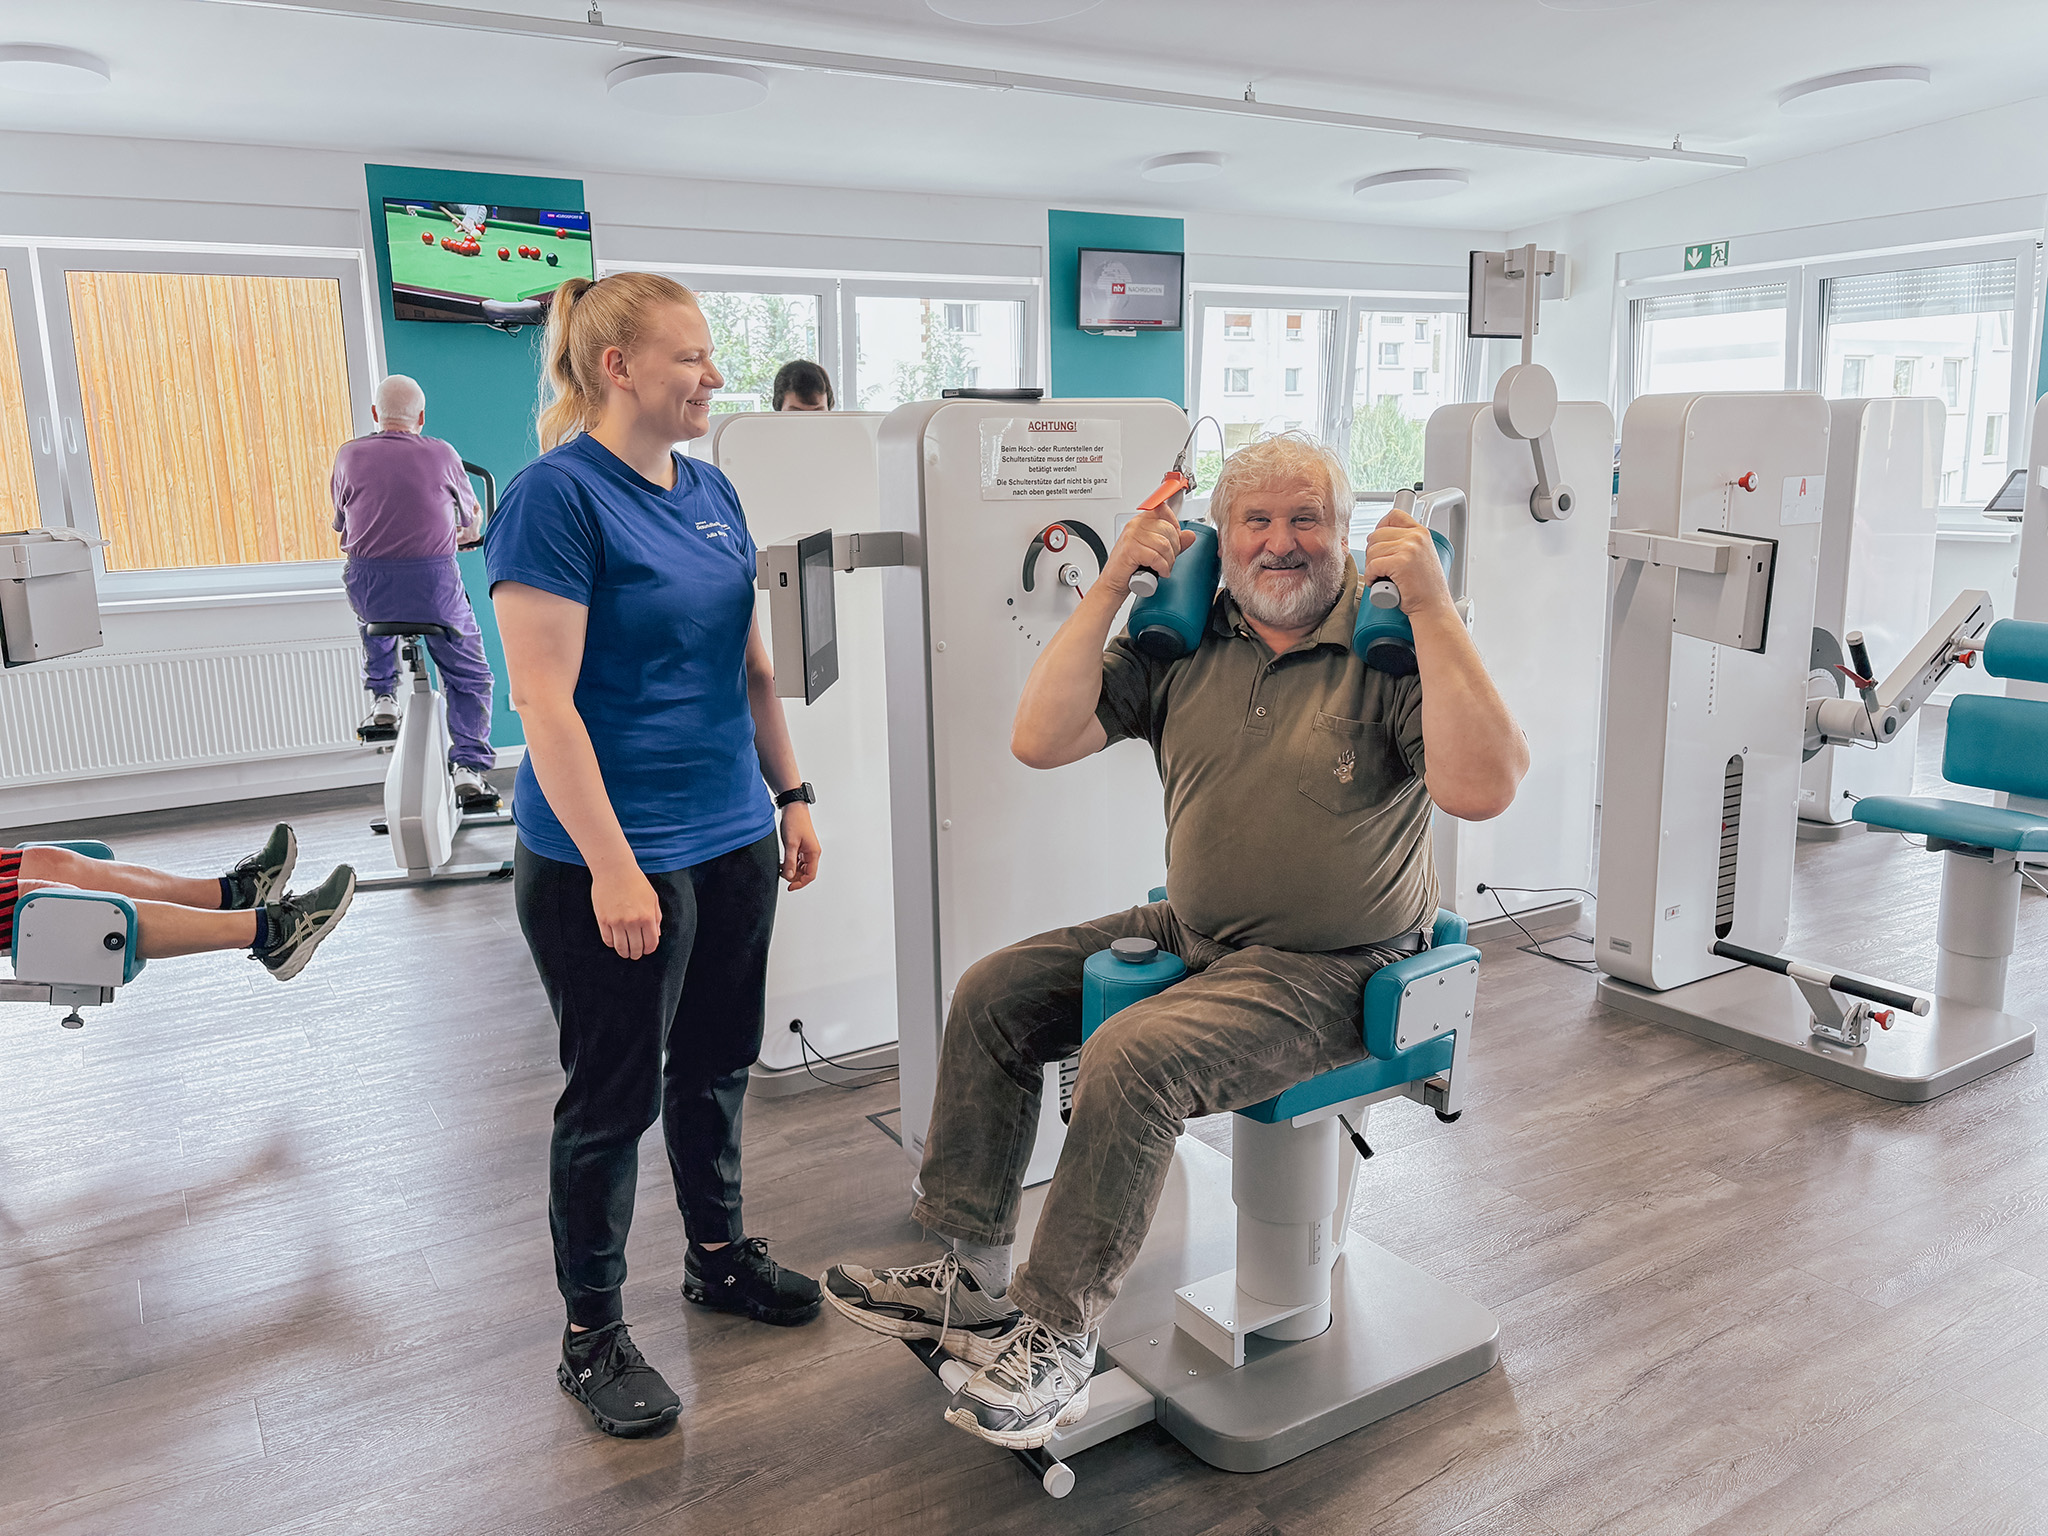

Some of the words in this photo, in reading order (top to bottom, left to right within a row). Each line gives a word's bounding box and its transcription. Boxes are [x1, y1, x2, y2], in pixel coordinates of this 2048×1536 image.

[1113, 284, 1124, 292] ntv
[1028, 421, 1077, 432] ACHTUNG!
[1001, 455, 1046, 463] Schulterstütze
[1089, 455, 1103, 463] Griff
[1028, 466, 1052, 474] betätigt
[1008, 478, 1052, 486] Schulterstütze
[1053, 477, 1066, 485] darf
[1045, 488, 1068, 496] gestellt
[1069, 487, 1093, 495] werden!
[1799, 478, 1807, 496] A
